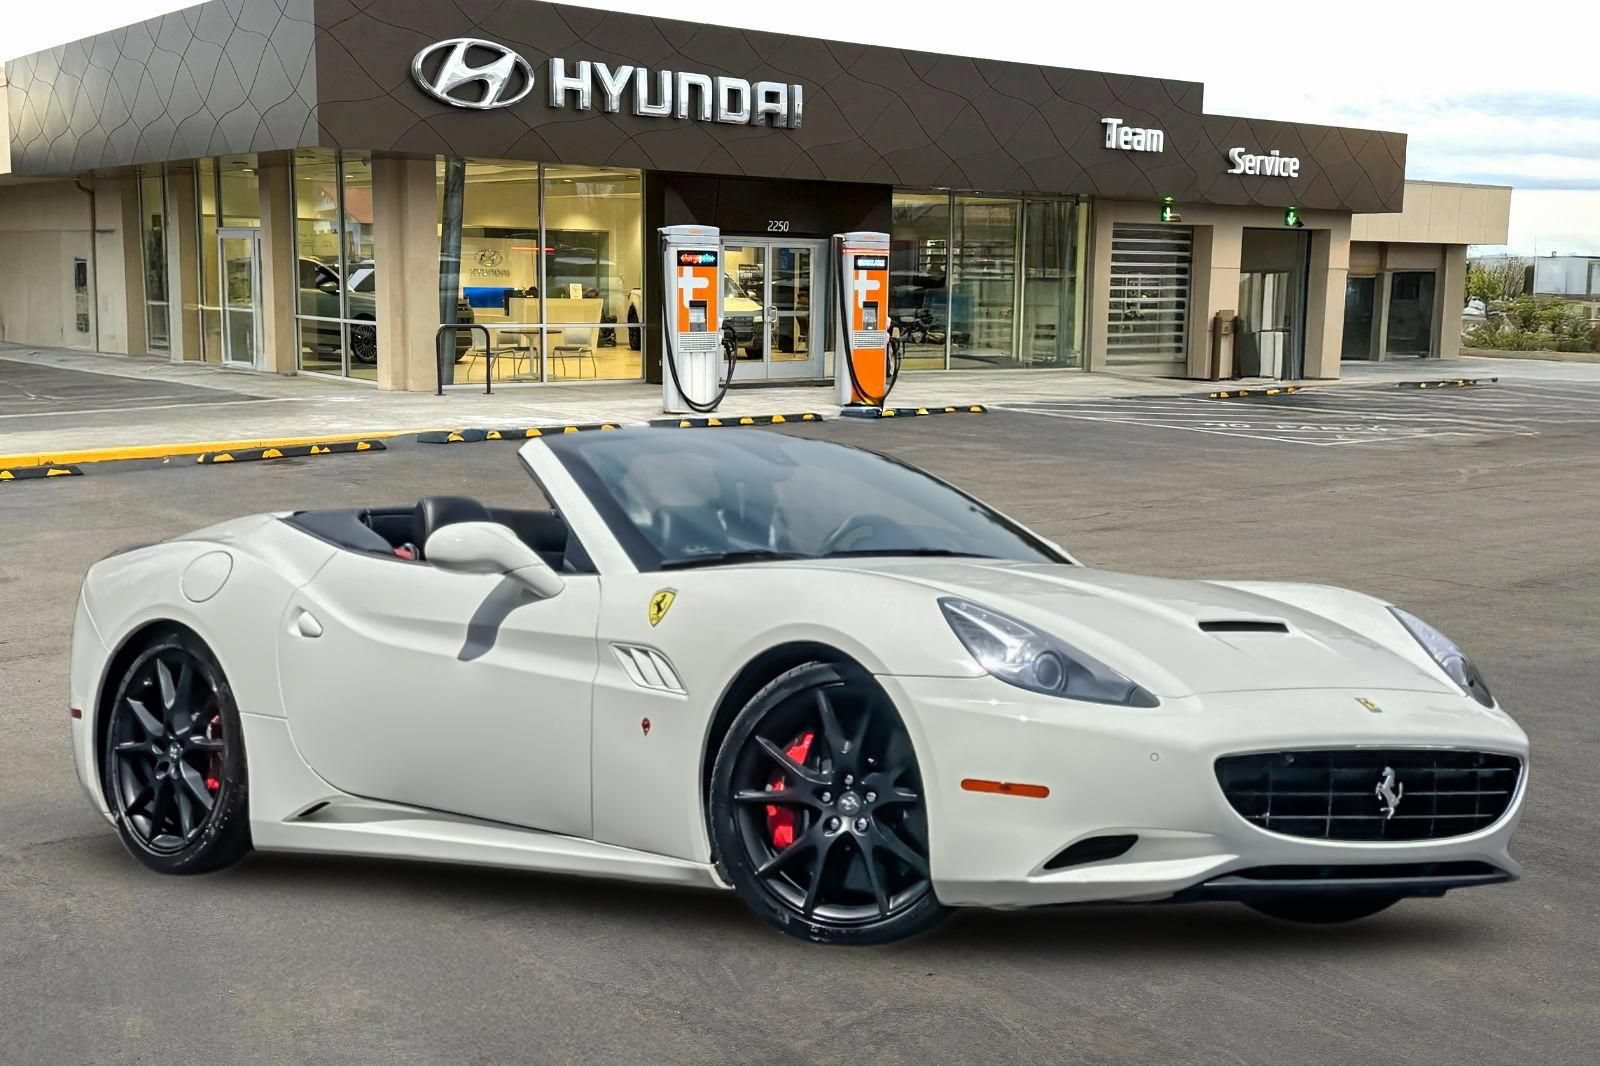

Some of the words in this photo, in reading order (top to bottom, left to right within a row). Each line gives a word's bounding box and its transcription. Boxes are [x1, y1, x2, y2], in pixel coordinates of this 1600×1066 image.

[548, 57, 803, 129] HYUNDAI
[1101, 117, 1164, 152] Team
[1227, 147, 1300, 178] Service
[767, 220, 789, 232] 2250
